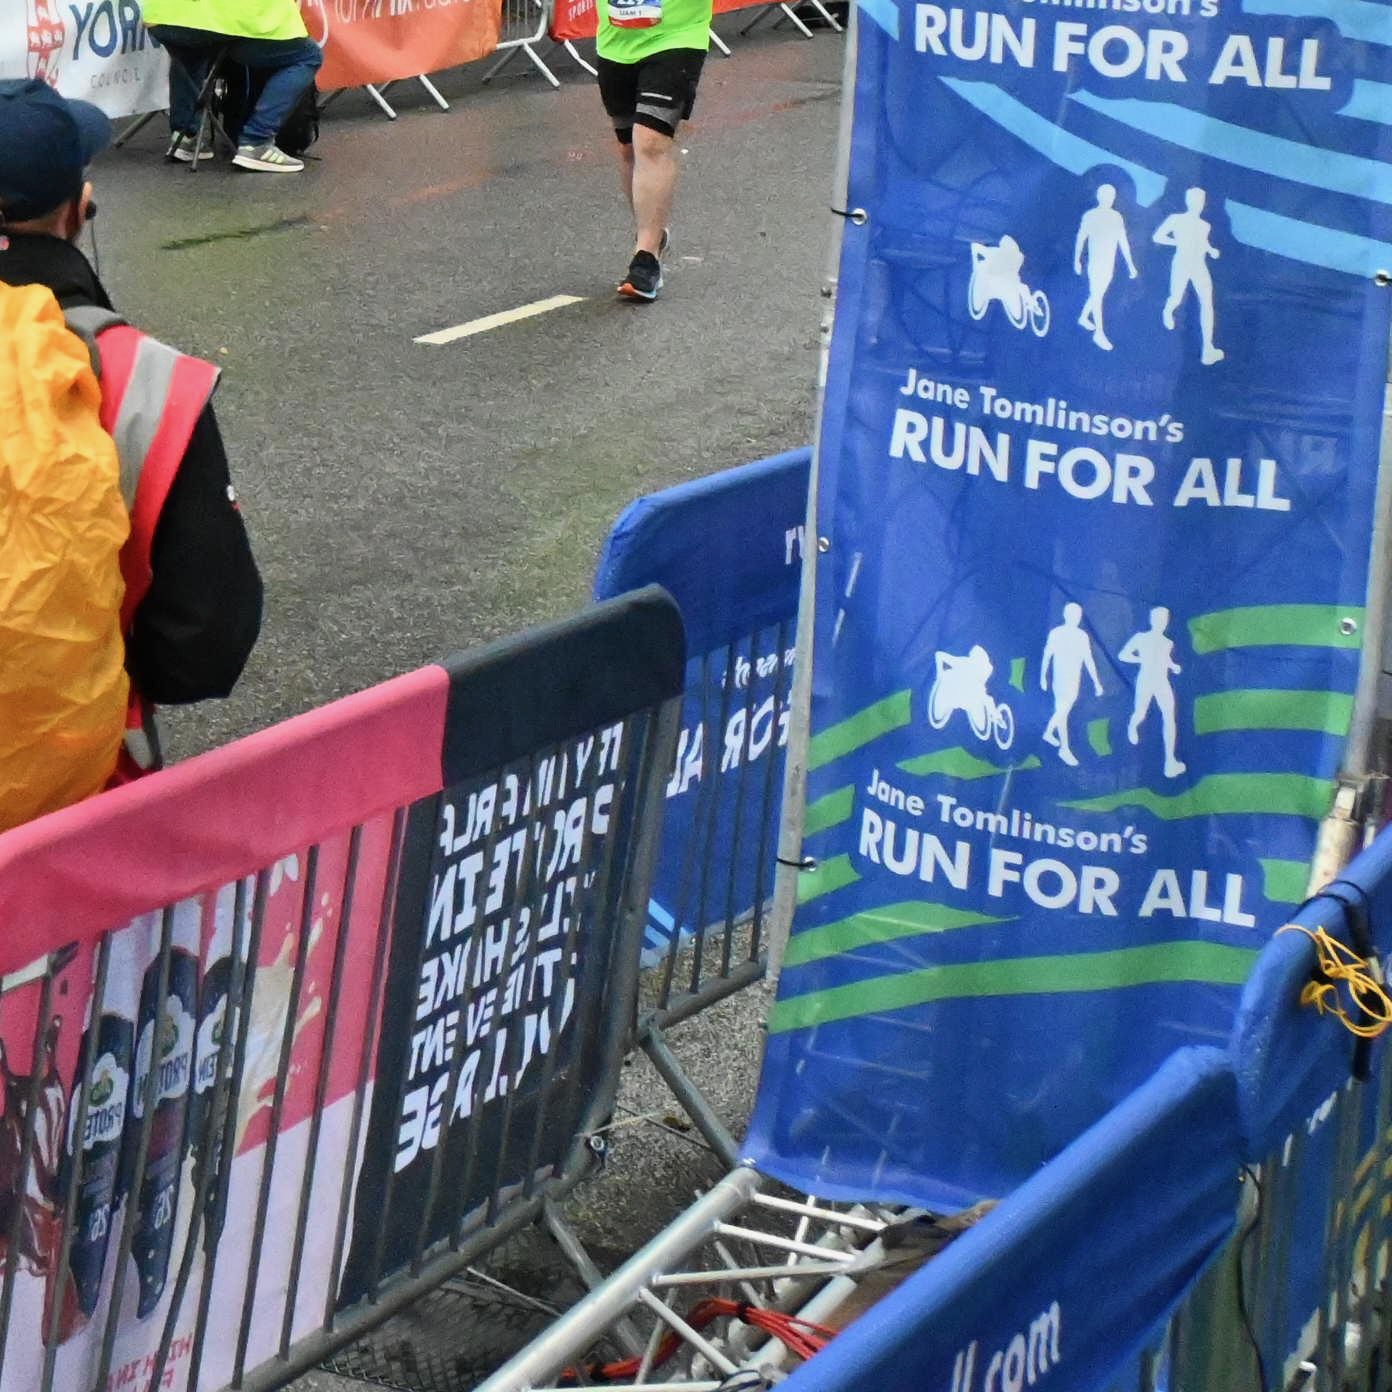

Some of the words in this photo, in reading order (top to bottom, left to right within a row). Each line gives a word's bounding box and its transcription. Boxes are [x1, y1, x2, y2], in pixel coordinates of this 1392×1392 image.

[914, 3, 1035, 70] RUN
[1053, 21, 1190, 82] FOR
[1208, 34, 1332, 91] ALL
[900, 368, 970, 408] Jane
[978, 385, 1184, 444] Tomlinson's
[889, 408, 1009, 483] RUN
[1024, 440, 1156, 506] FOR
[1173, 455, 1291, 511] ALL
[866, 768, 925, 815] Jane
[936, 793, 1147, 855] Tomlinson's
[858, 807, 971, 890] RUN
[987, 846, 1118, 917] FOR
[1137, 868, 1256, 927] ALL
